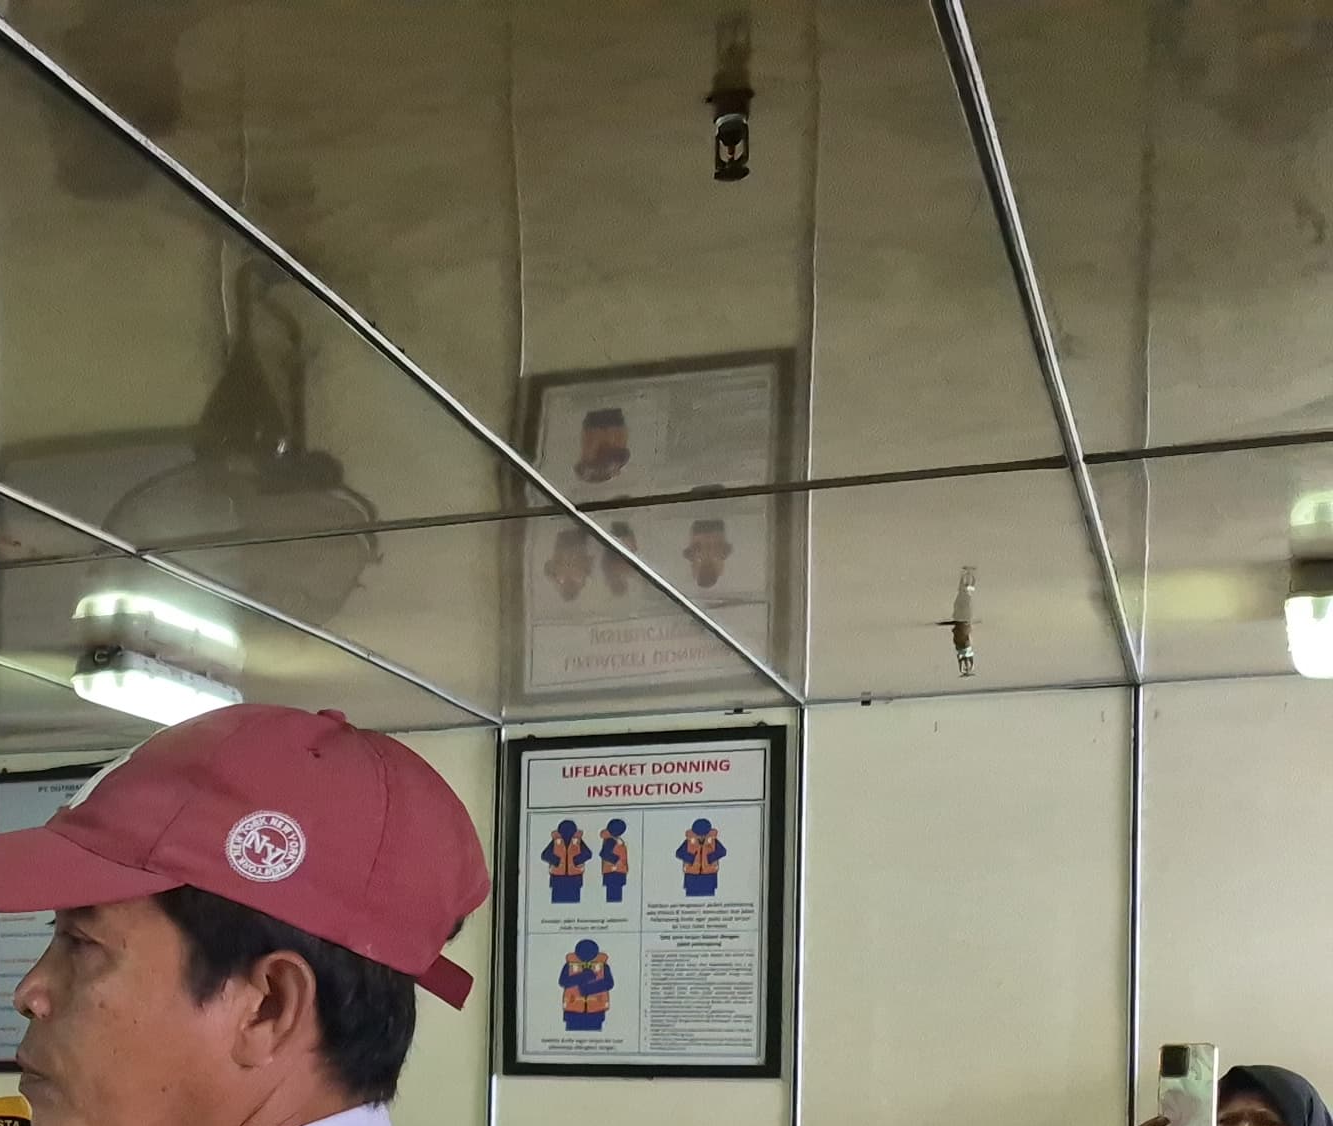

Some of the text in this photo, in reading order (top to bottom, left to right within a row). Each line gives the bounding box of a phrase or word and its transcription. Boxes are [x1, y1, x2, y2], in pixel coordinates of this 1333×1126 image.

[562, 759, 731, 778] LIFEJACKET DONNING
[587, 781, 704, 798] INSTRUCTIONS
[244, 830, 288, 866] NY
